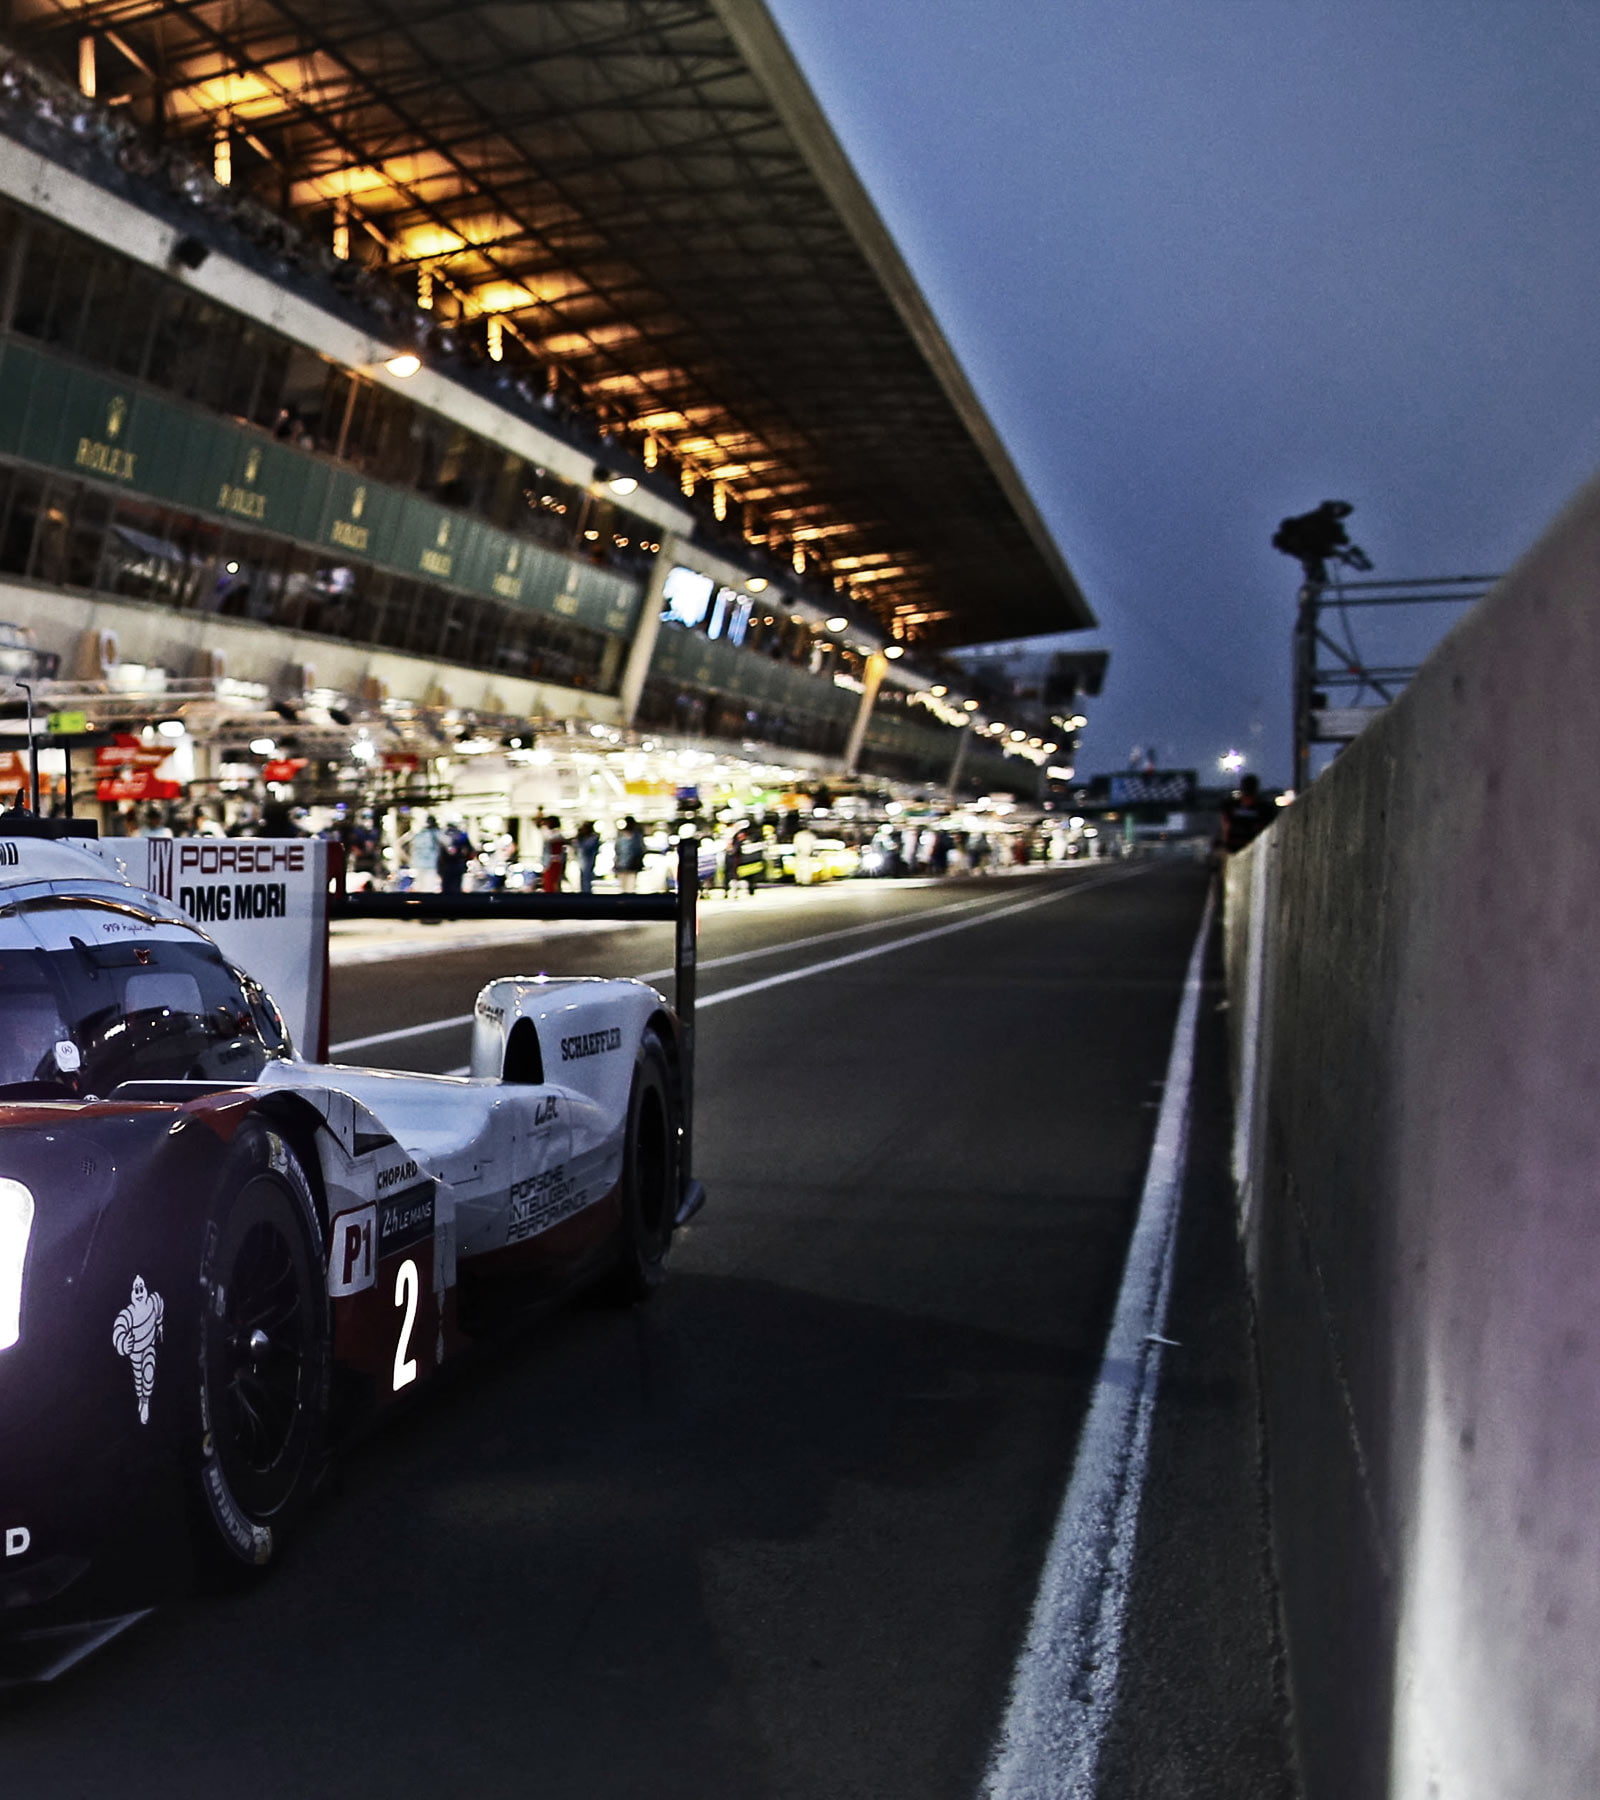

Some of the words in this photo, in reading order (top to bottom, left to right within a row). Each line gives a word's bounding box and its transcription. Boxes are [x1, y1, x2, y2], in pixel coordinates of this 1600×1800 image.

[75, 437, 138, 480] ROLEX
[180, 845, 304, 875] PORSCHE
[180, 885, 231, 921] DMG
[234, 883, 286, 919] MORI
[561, 1027, 621, 1061] SCHAEFFLER
[377, 1160, 418, 1190] CHOPARD
[510, 1164, 564, 1203] PORSCHE
[400, 1212, 409, 1229] LE
[410, 1201, 432, 1222] MANS
[343, 1219, 372, 1284] P1
[393, 1260, 419, 1392] 2
